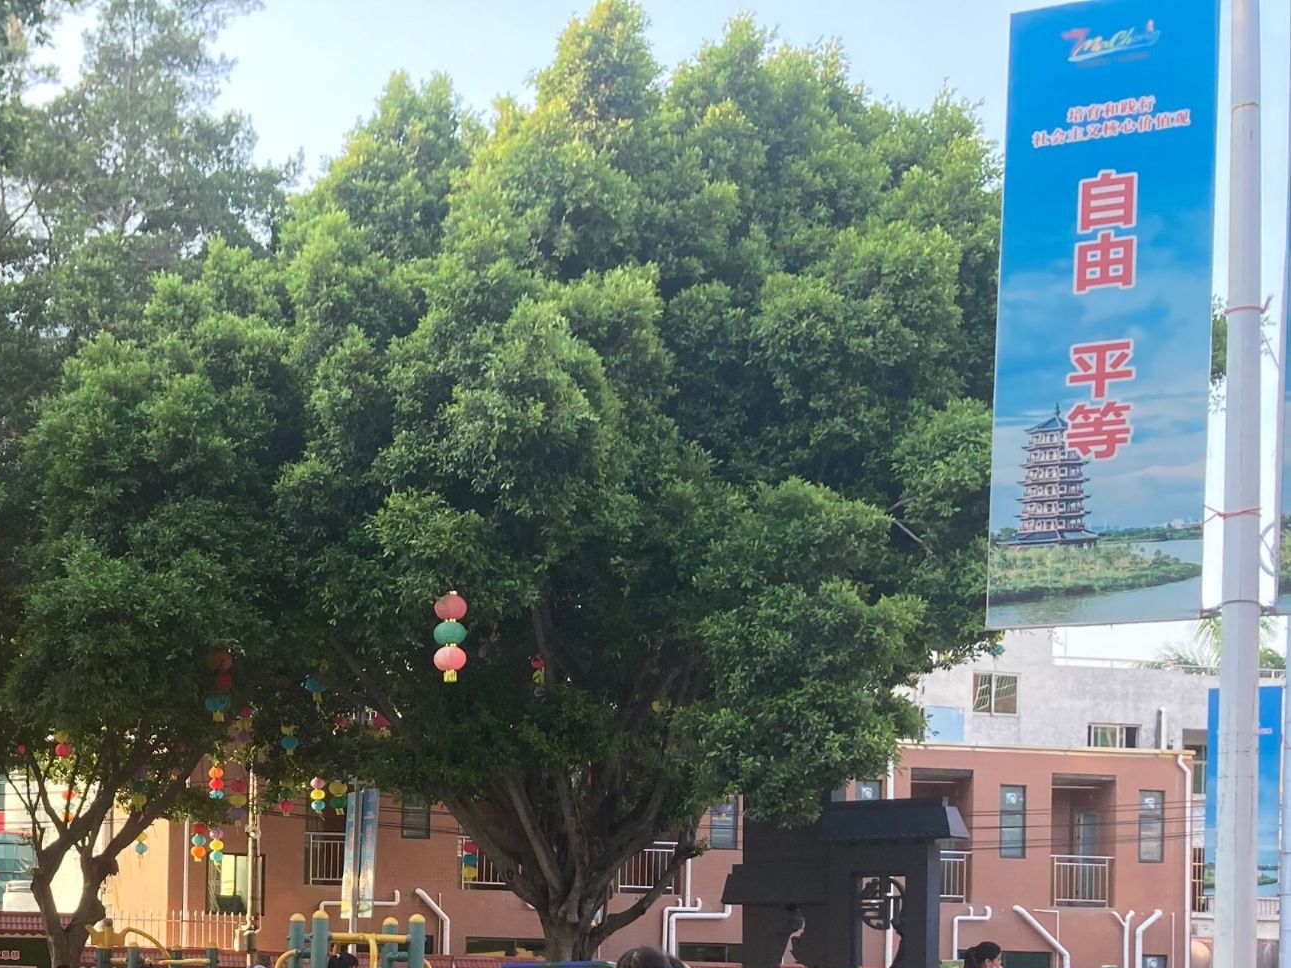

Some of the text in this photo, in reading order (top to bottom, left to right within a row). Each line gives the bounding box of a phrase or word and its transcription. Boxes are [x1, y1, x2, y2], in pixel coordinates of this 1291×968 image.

[1032, 109, 1190, 148] 社会主义核心价值观
[1067, 95, 1156, 123] 培育和践行
[1066, 169, 1138, 459] 自由 平等
